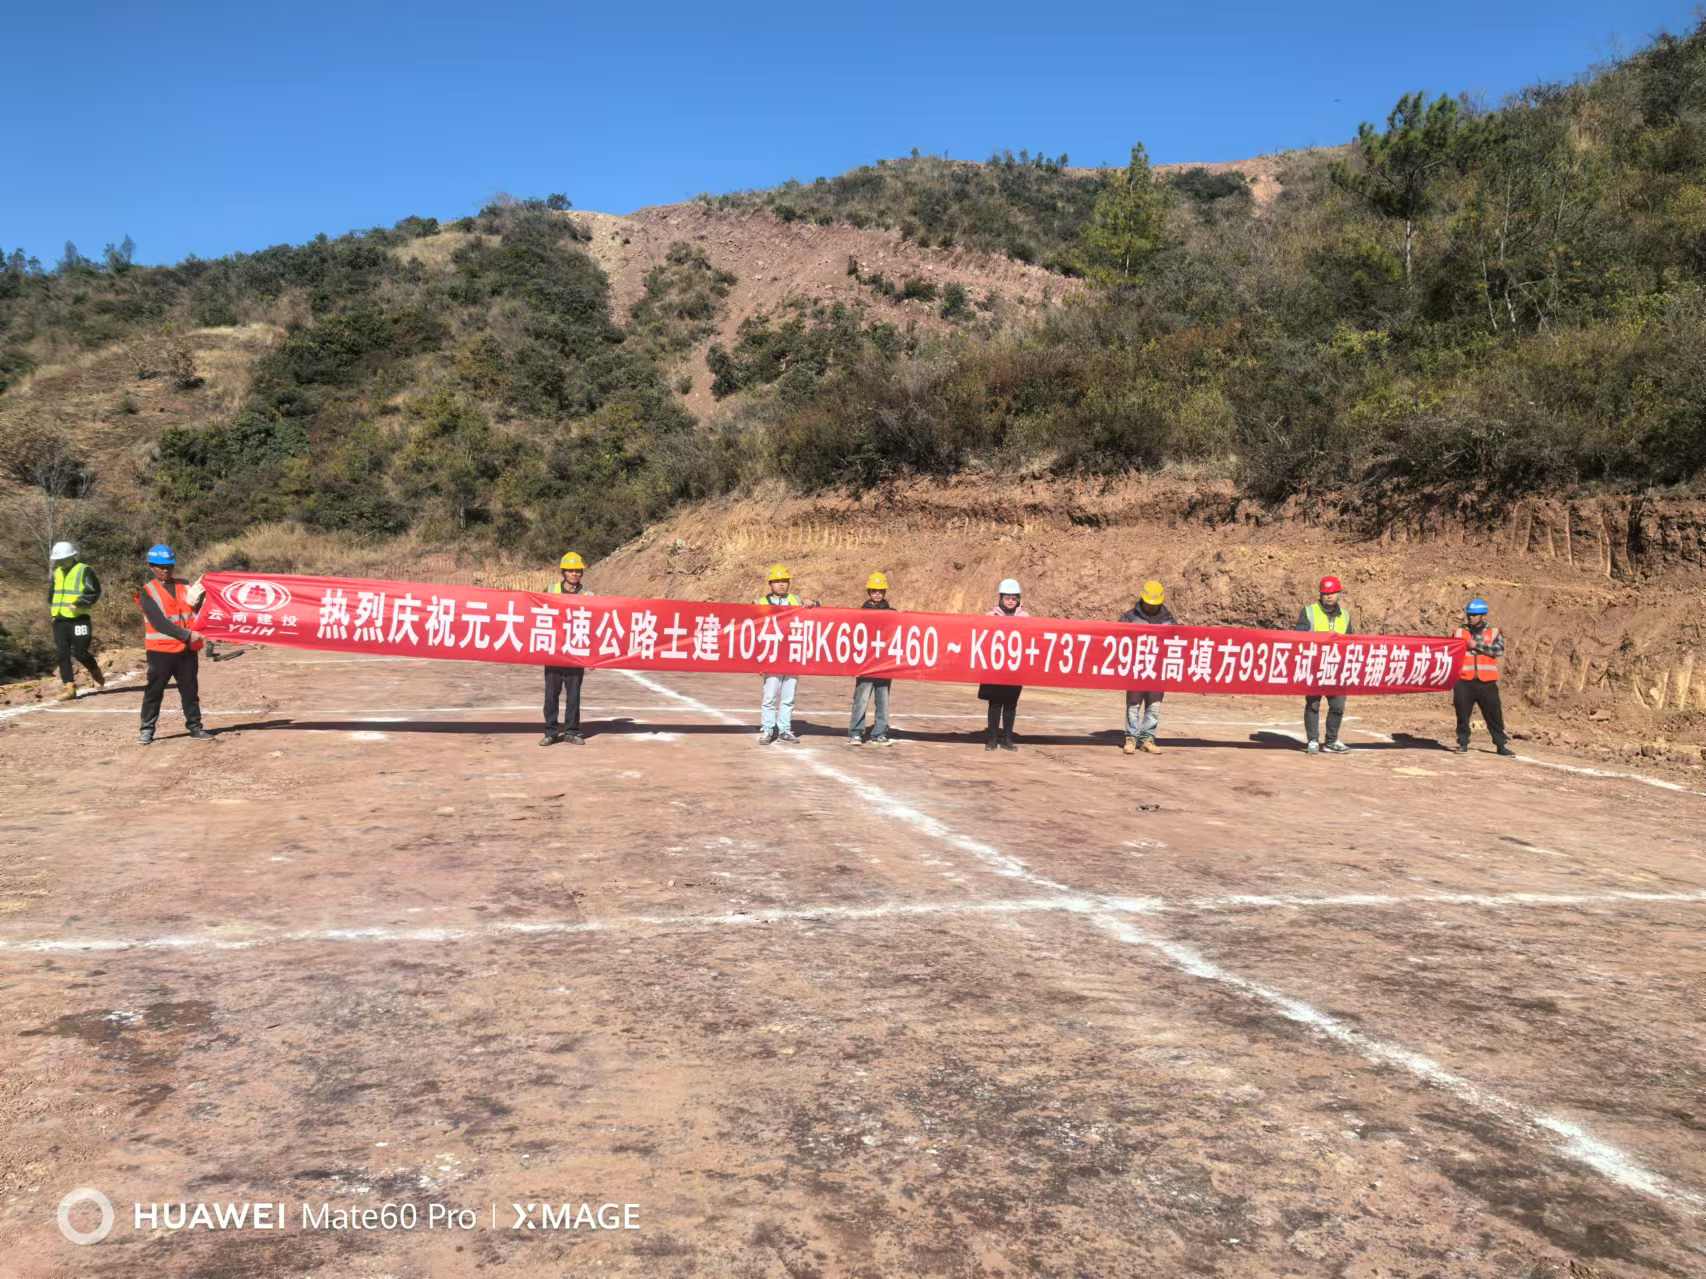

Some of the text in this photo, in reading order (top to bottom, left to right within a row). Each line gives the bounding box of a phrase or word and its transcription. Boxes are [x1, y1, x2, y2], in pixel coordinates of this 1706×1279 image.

[208, 609, 298, 627] 云南建投
[228, 624, 276, 636] YCIH
